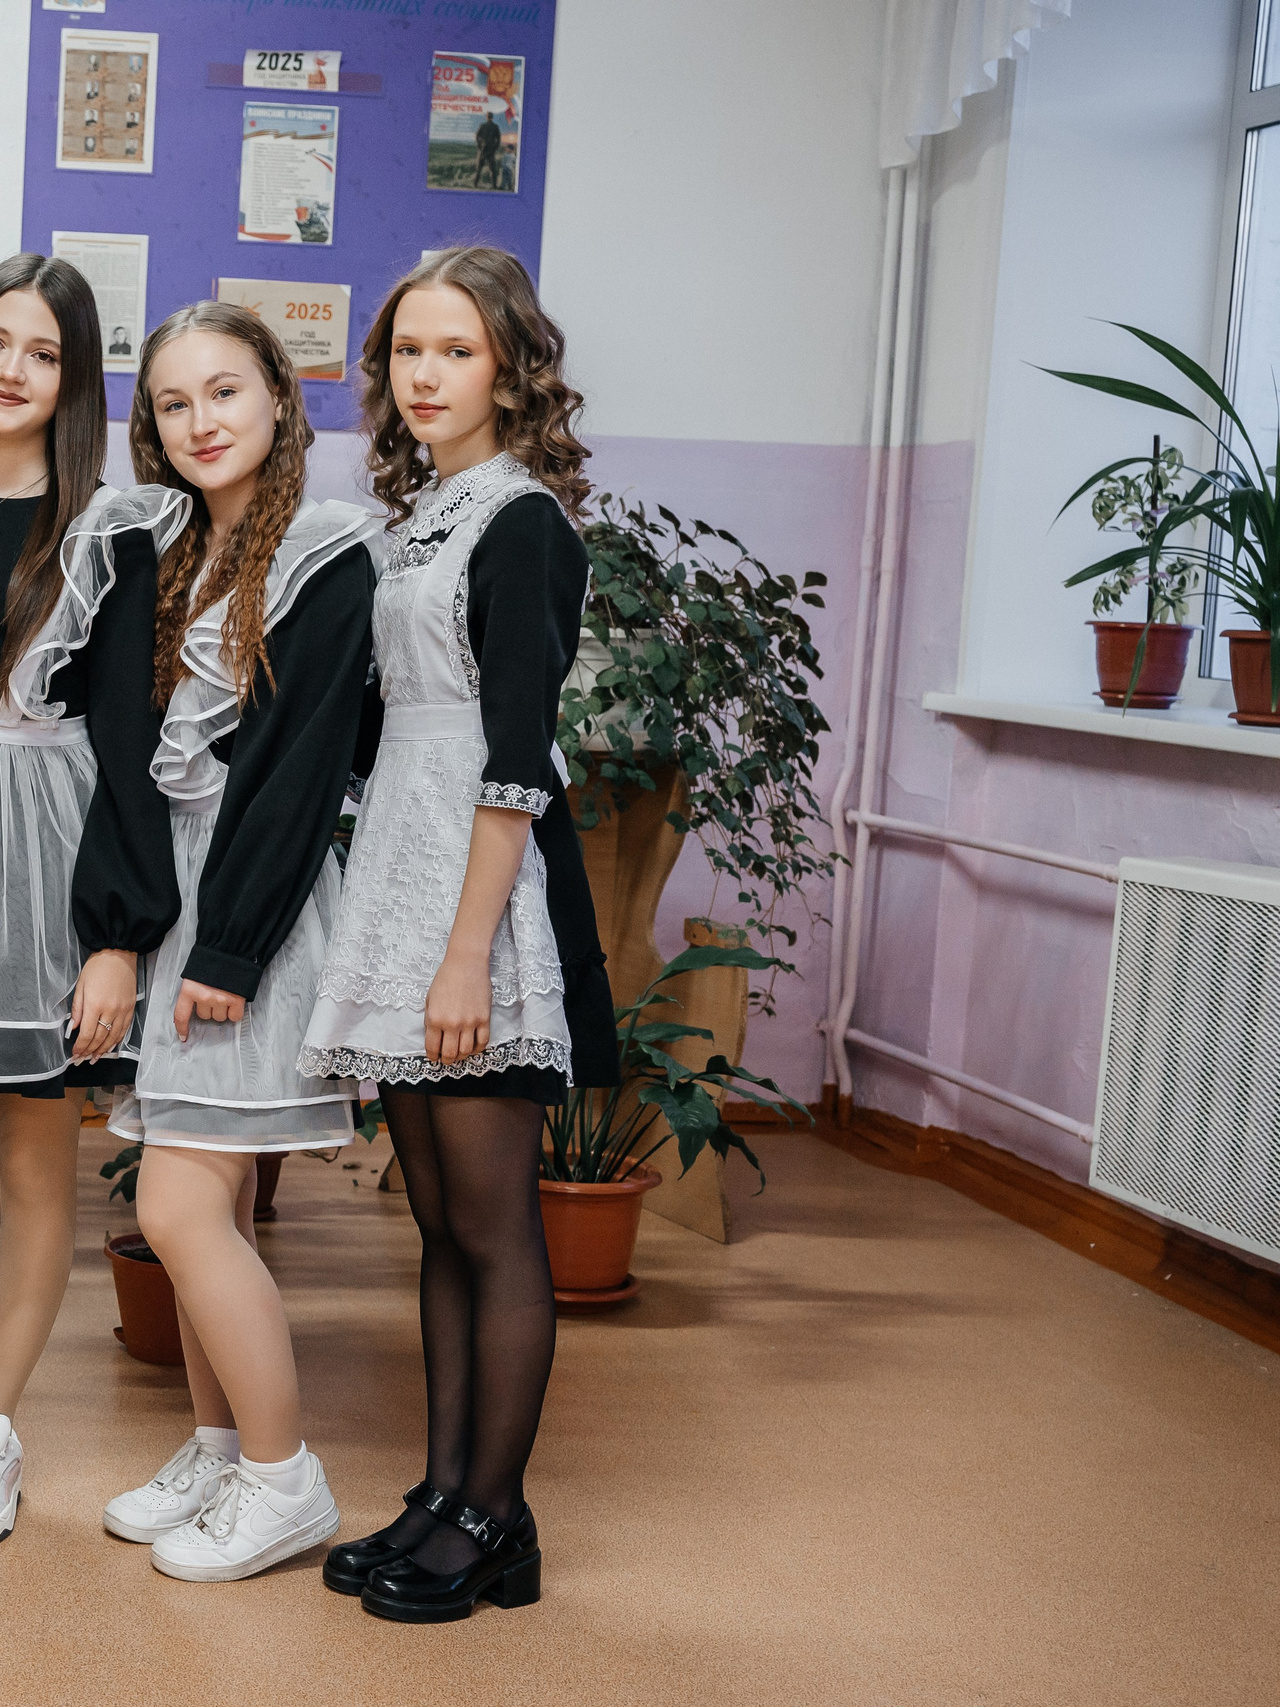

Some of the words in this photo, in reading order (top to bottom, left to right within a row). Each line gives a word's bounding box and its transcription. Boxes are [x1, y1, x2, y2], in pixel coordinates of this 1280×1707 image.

[256, 51, 305, 71] 2025
[433, 66, 475, 83] 2025
[285, 302, 333, 320] 2025
